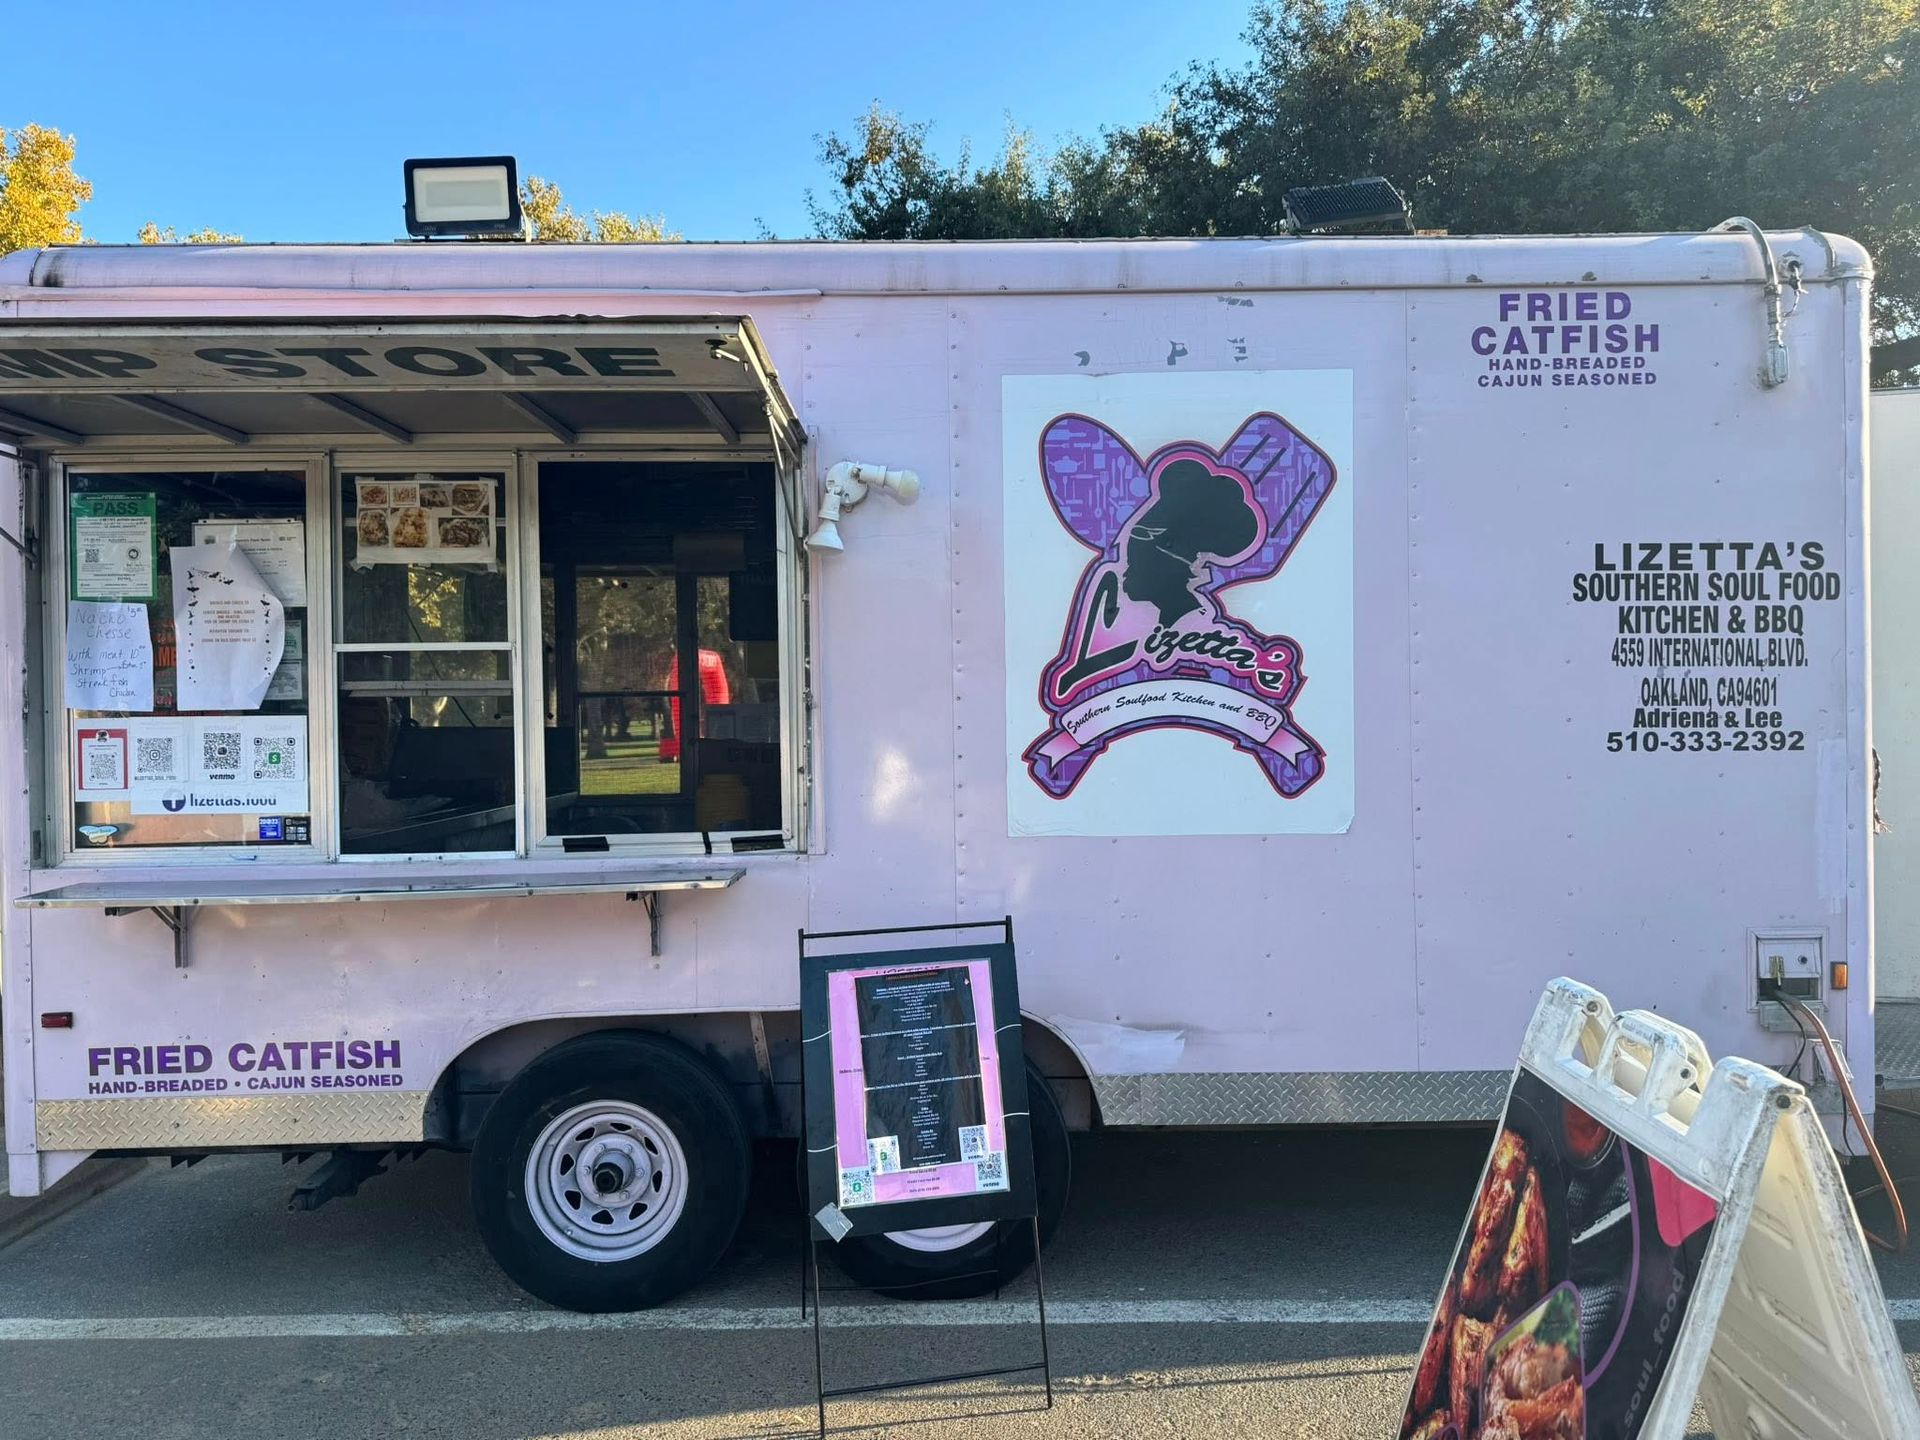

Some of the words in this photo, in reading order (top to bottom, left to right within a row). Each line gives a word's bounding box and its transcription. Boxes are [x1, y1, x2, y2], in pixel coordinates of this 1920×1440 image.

[1499, 291, 1632, 322] FRIED
[1471, 323, 1660, 355] CATFISH
[194, 346, 676, 378] STORE
[1488, 356, 1646, 371] HAND-BREADED
[1477, 374, 1543, 388] CAJUN
[1551, 372, 1658, 387] SEASONED
[92, 501, 139, 516] PASS
[1594, 541, 1826, 572] LIZETTA'S
[1572, 573, 1700, 602] SOUTHERN
[1707, 572, 1771, 602] SOUL
[1778, 572, 1842, 601] FOOD
[1058, 571, 1285, 696] Lizetta's
[1618, 605, 1720, 634] KITCHEN
[1727, 605, 1747, 634] &
[1754, 604, 1805, 637] BBQ
[1611, 638, 1644, 667] 4559
[1649, 637, 1763, 668] INTERNATIONAL
[1768, 638, 1809, 668] BLVD.
[1066, 703, 1112, 734] Southern
[1115, 692, 1167, 709] Soulfood
[1171, 691, 1216, 706] Kitchen
[1218, 702, 1243, 714] and
[1246, 707, 1278, 731] BBQ
[1633, 707, 1719, 729] Adriena
[1724, 710, 1740, 729] &
[1745, 707, 1783, 729] Lee
[1606, 731, 1806, 753] 510-333-2392
[88, 1045, 213, 1077] FRIED
[228, 1040, 401, 1073] CATFISH
[88, 1078, 228, 1095] HAND-BREADED
[247, 1076, 305, 1091] CAJUN
[310, 1074, 403, 1089] SEASONED
